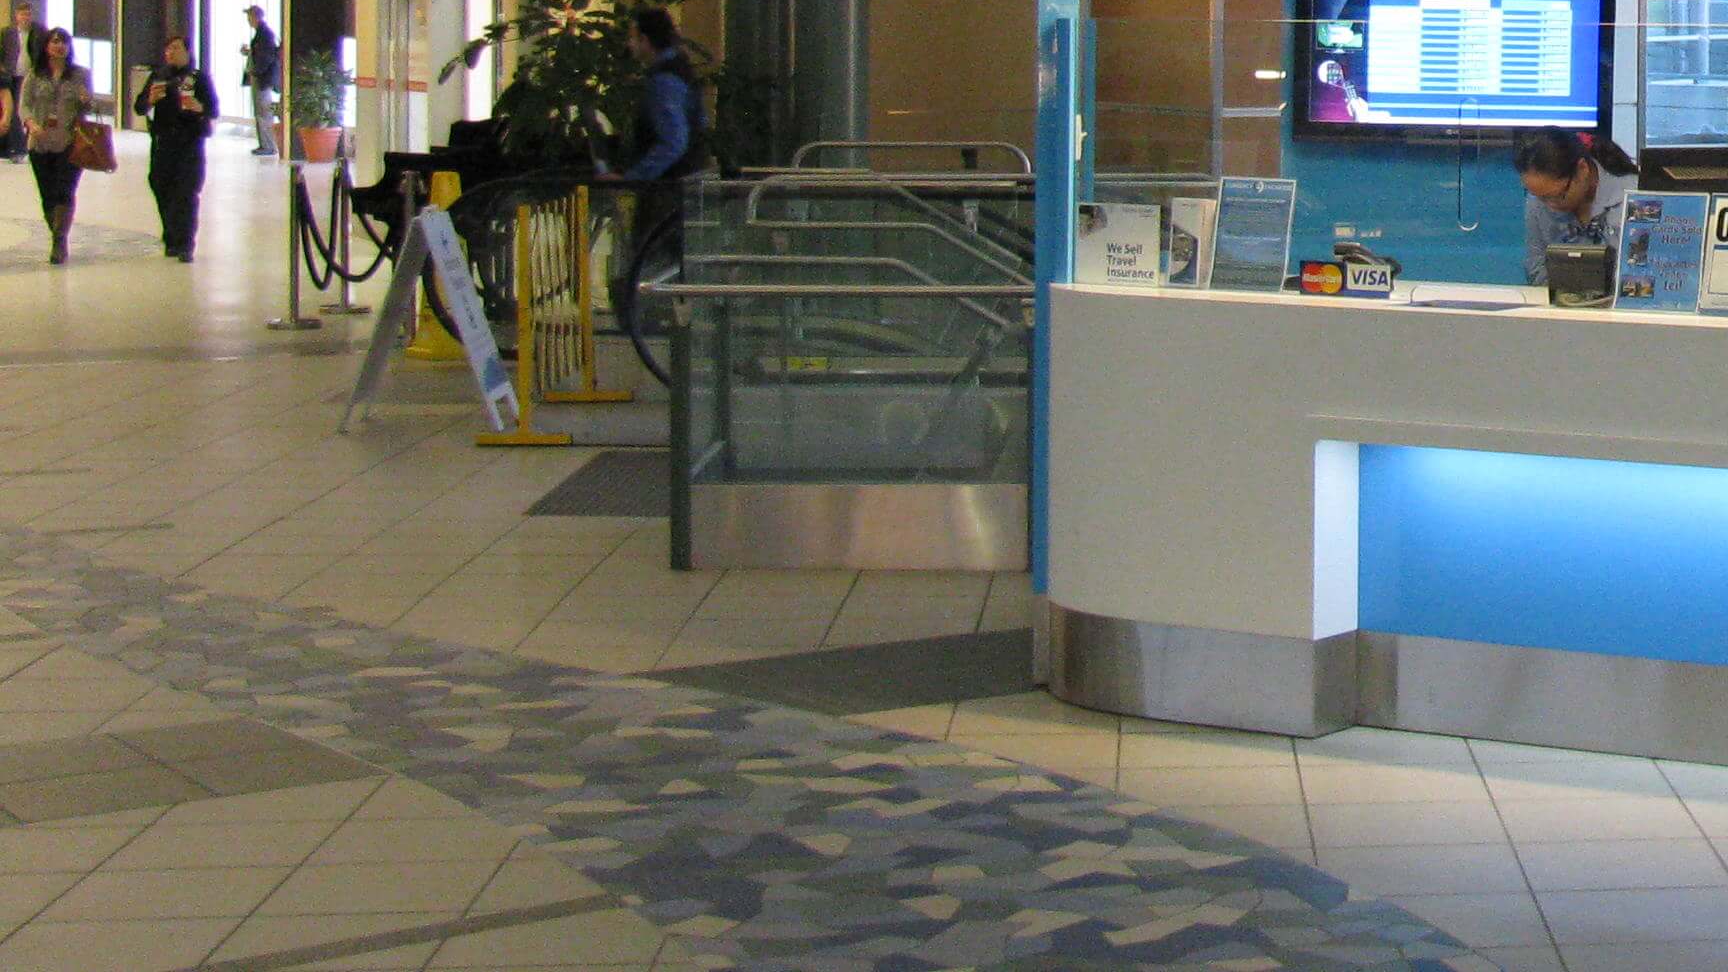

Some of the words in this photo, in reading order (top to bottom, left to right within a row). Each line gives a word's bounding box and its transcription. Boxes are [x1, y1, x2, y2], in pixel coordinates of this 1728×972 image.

[1106, 242, 1122, 254] We
[1124, 243, 1143, 254] Sell
[1106, 254, 1137, 266] Travel
[1106, 267, 1155, 279] Insurance
[1352, 268, 1388, 286] VISA
